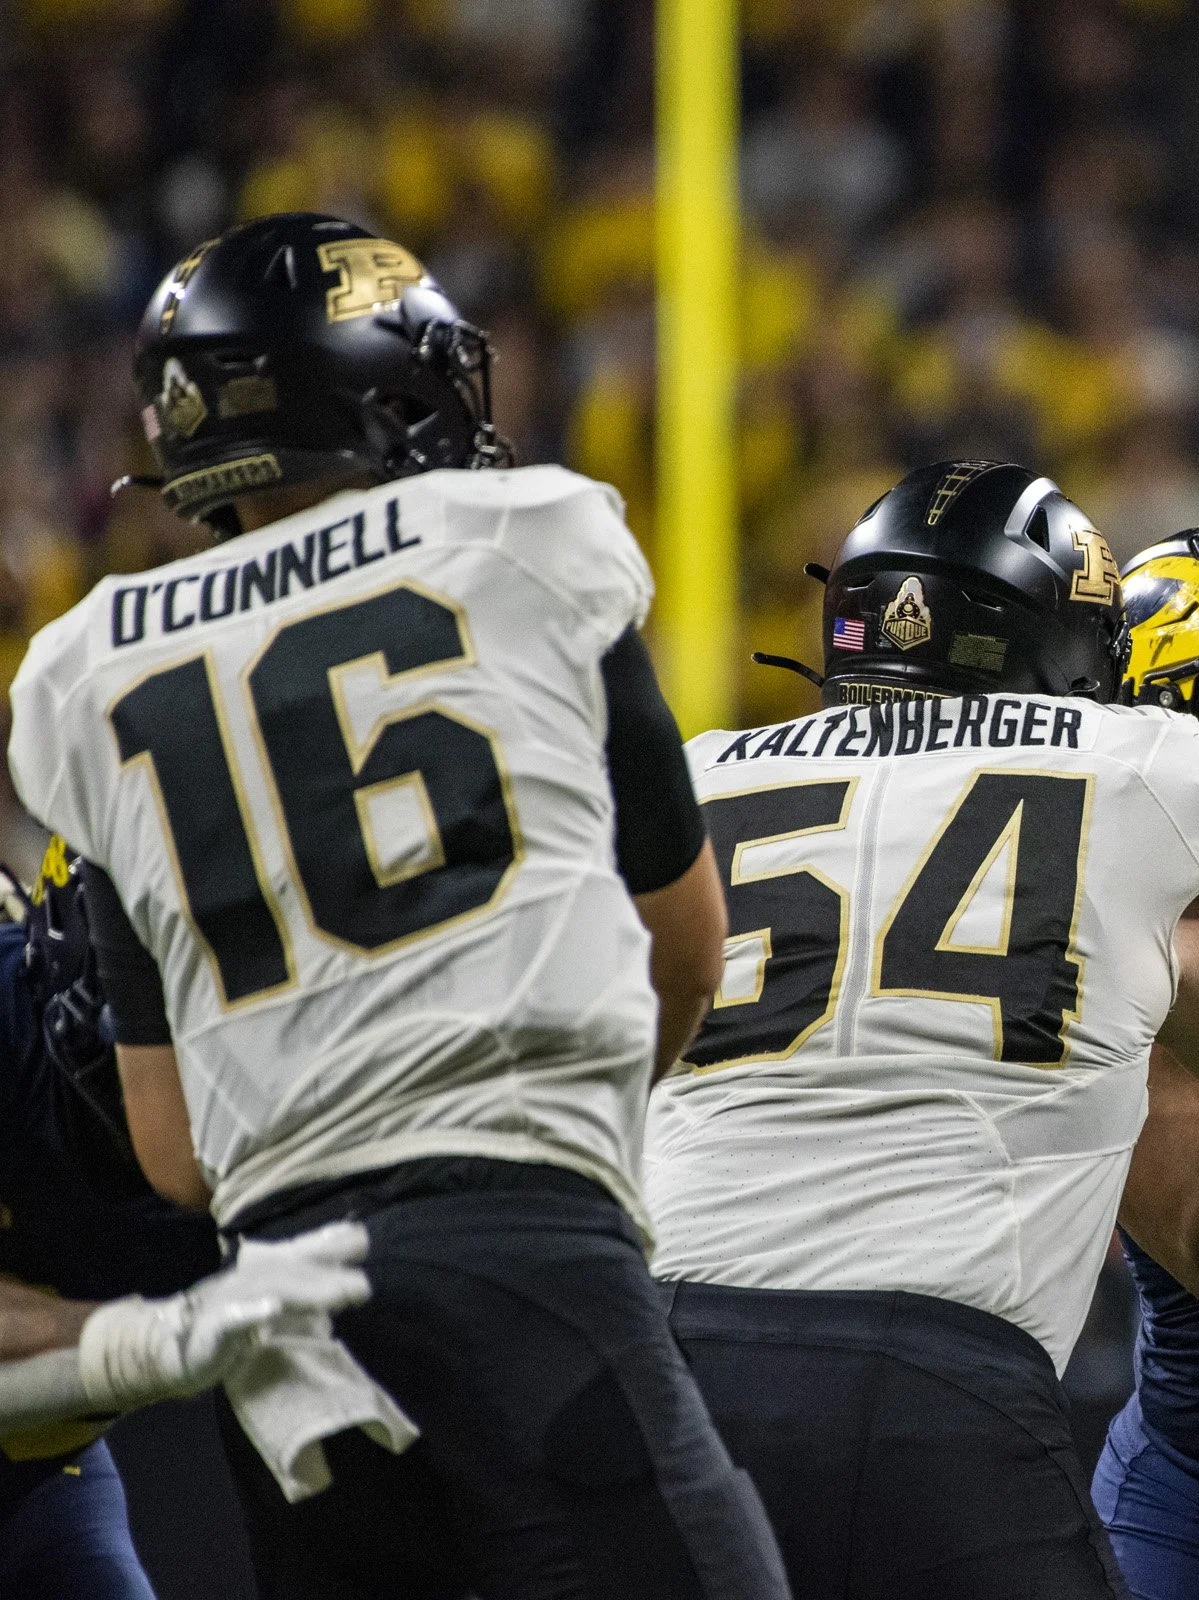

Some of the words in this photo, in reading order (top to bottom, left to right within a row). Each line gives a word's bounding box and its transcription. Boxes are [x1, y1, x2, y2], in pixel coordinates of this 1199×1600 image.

[317, 238, 426, 323] P
[112, 499, 422, 648] O'CONNELL
[886, 619, 927, 642] PURDUE
[717, 695, 1082, 763] KALTENBERGER
[107, 578, 525, 1013] 16
[680, 767, 1097, 1075] 54
